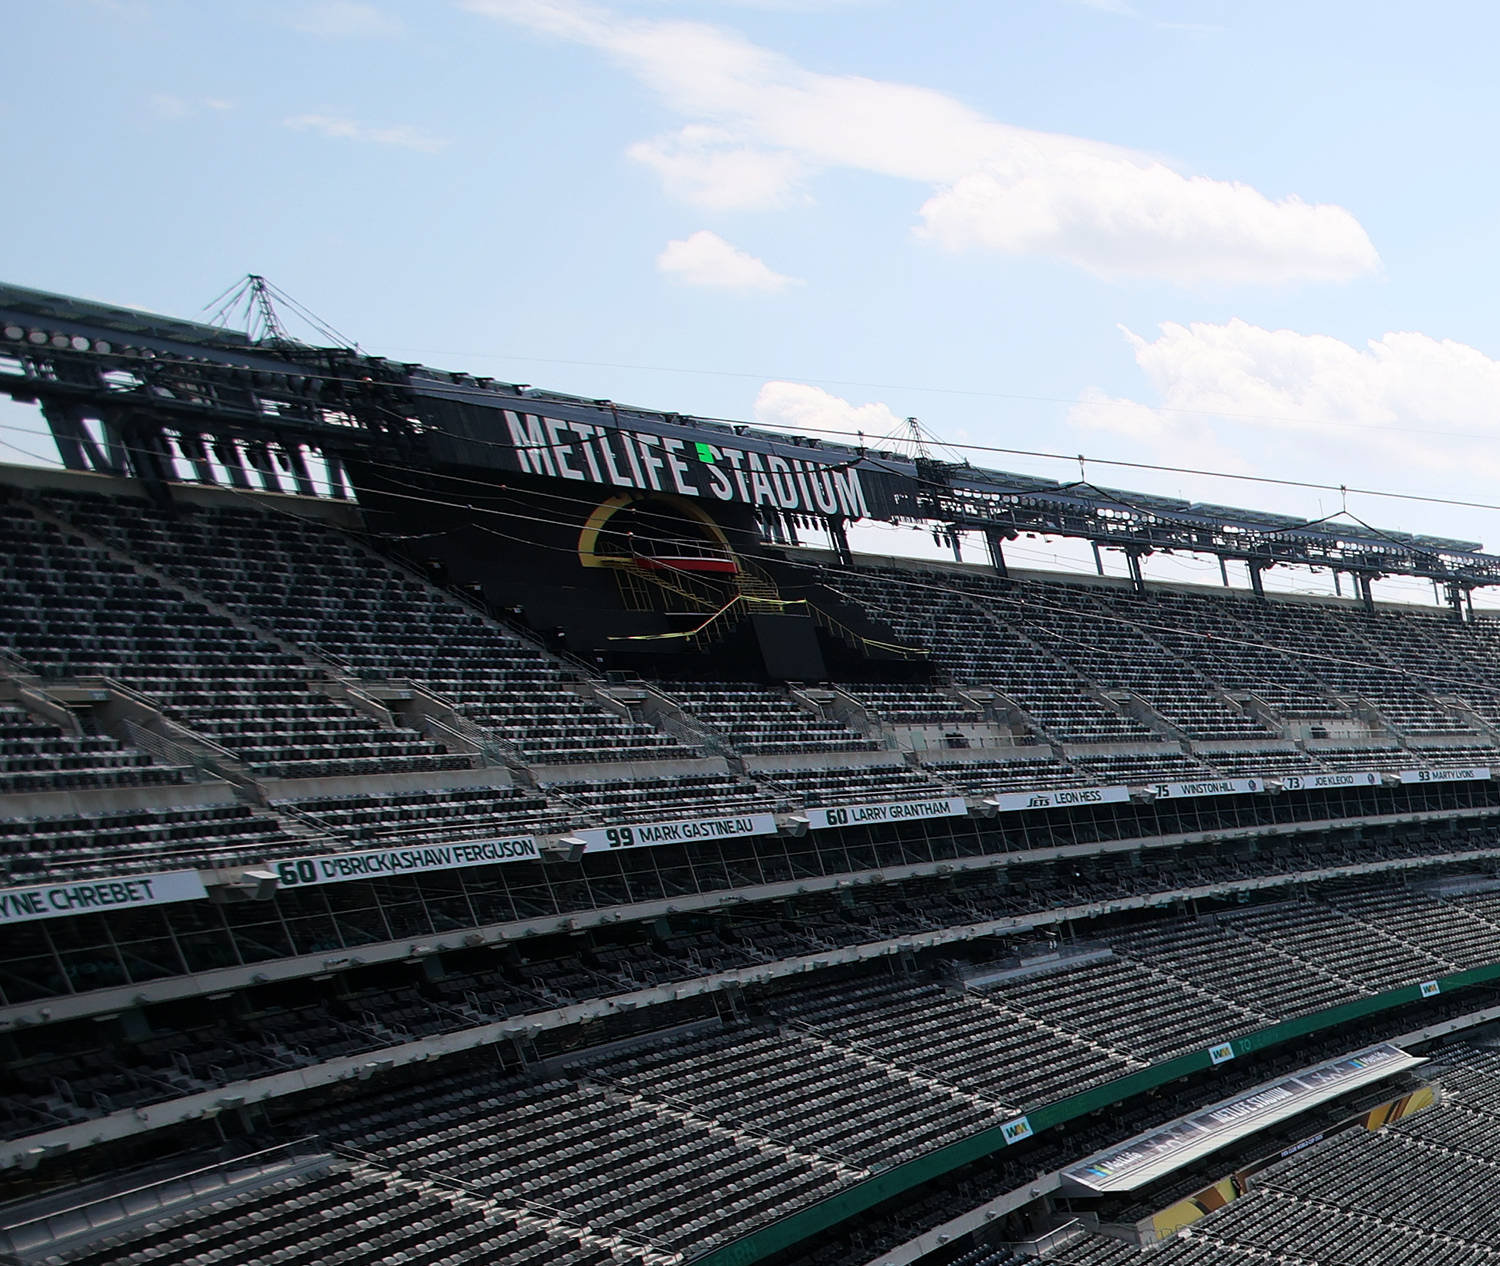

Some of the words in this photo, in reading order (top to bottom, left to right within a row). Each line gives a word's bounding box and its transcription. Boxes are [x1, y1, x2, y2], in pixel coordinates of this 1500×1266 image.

[503, 410, 698, 497] METLIFE
[706, 442, 873, 518] STADIUM
[1286, 777, 1300, 789] 73
[1314, 776, 1328, 786] JOE
[1418, 770, 1431, 781] 93
[1054, 793, 1080, 805] LEON
[1079, 790, 1102, 803] HESS
[1156, 785, 1169, 797] 75
[1181, 782, 1219, 794] WINSTON
[1219, 781, 1236, 792] HILL
[826, 808, 848, 826] 60
[851, 806, 887, 823] LARRY
[890, 801, 952, 819] GRANTHAM
[606, 828, 635, 848] 99
[639, 824, 681, 843] MARK
[683, 818, 754, 838] GASTINEAU
[279, 860, 317, 885] 60
[323, 847, 452, 880] D'BRICKASHAW
[452, 838, 535, 867] FERGUSON
[48, 879, 155, 913] CHREBET
[1212, 1046, 1230, 1061] WM
[1005, 1122, 1028, 1139] WM
